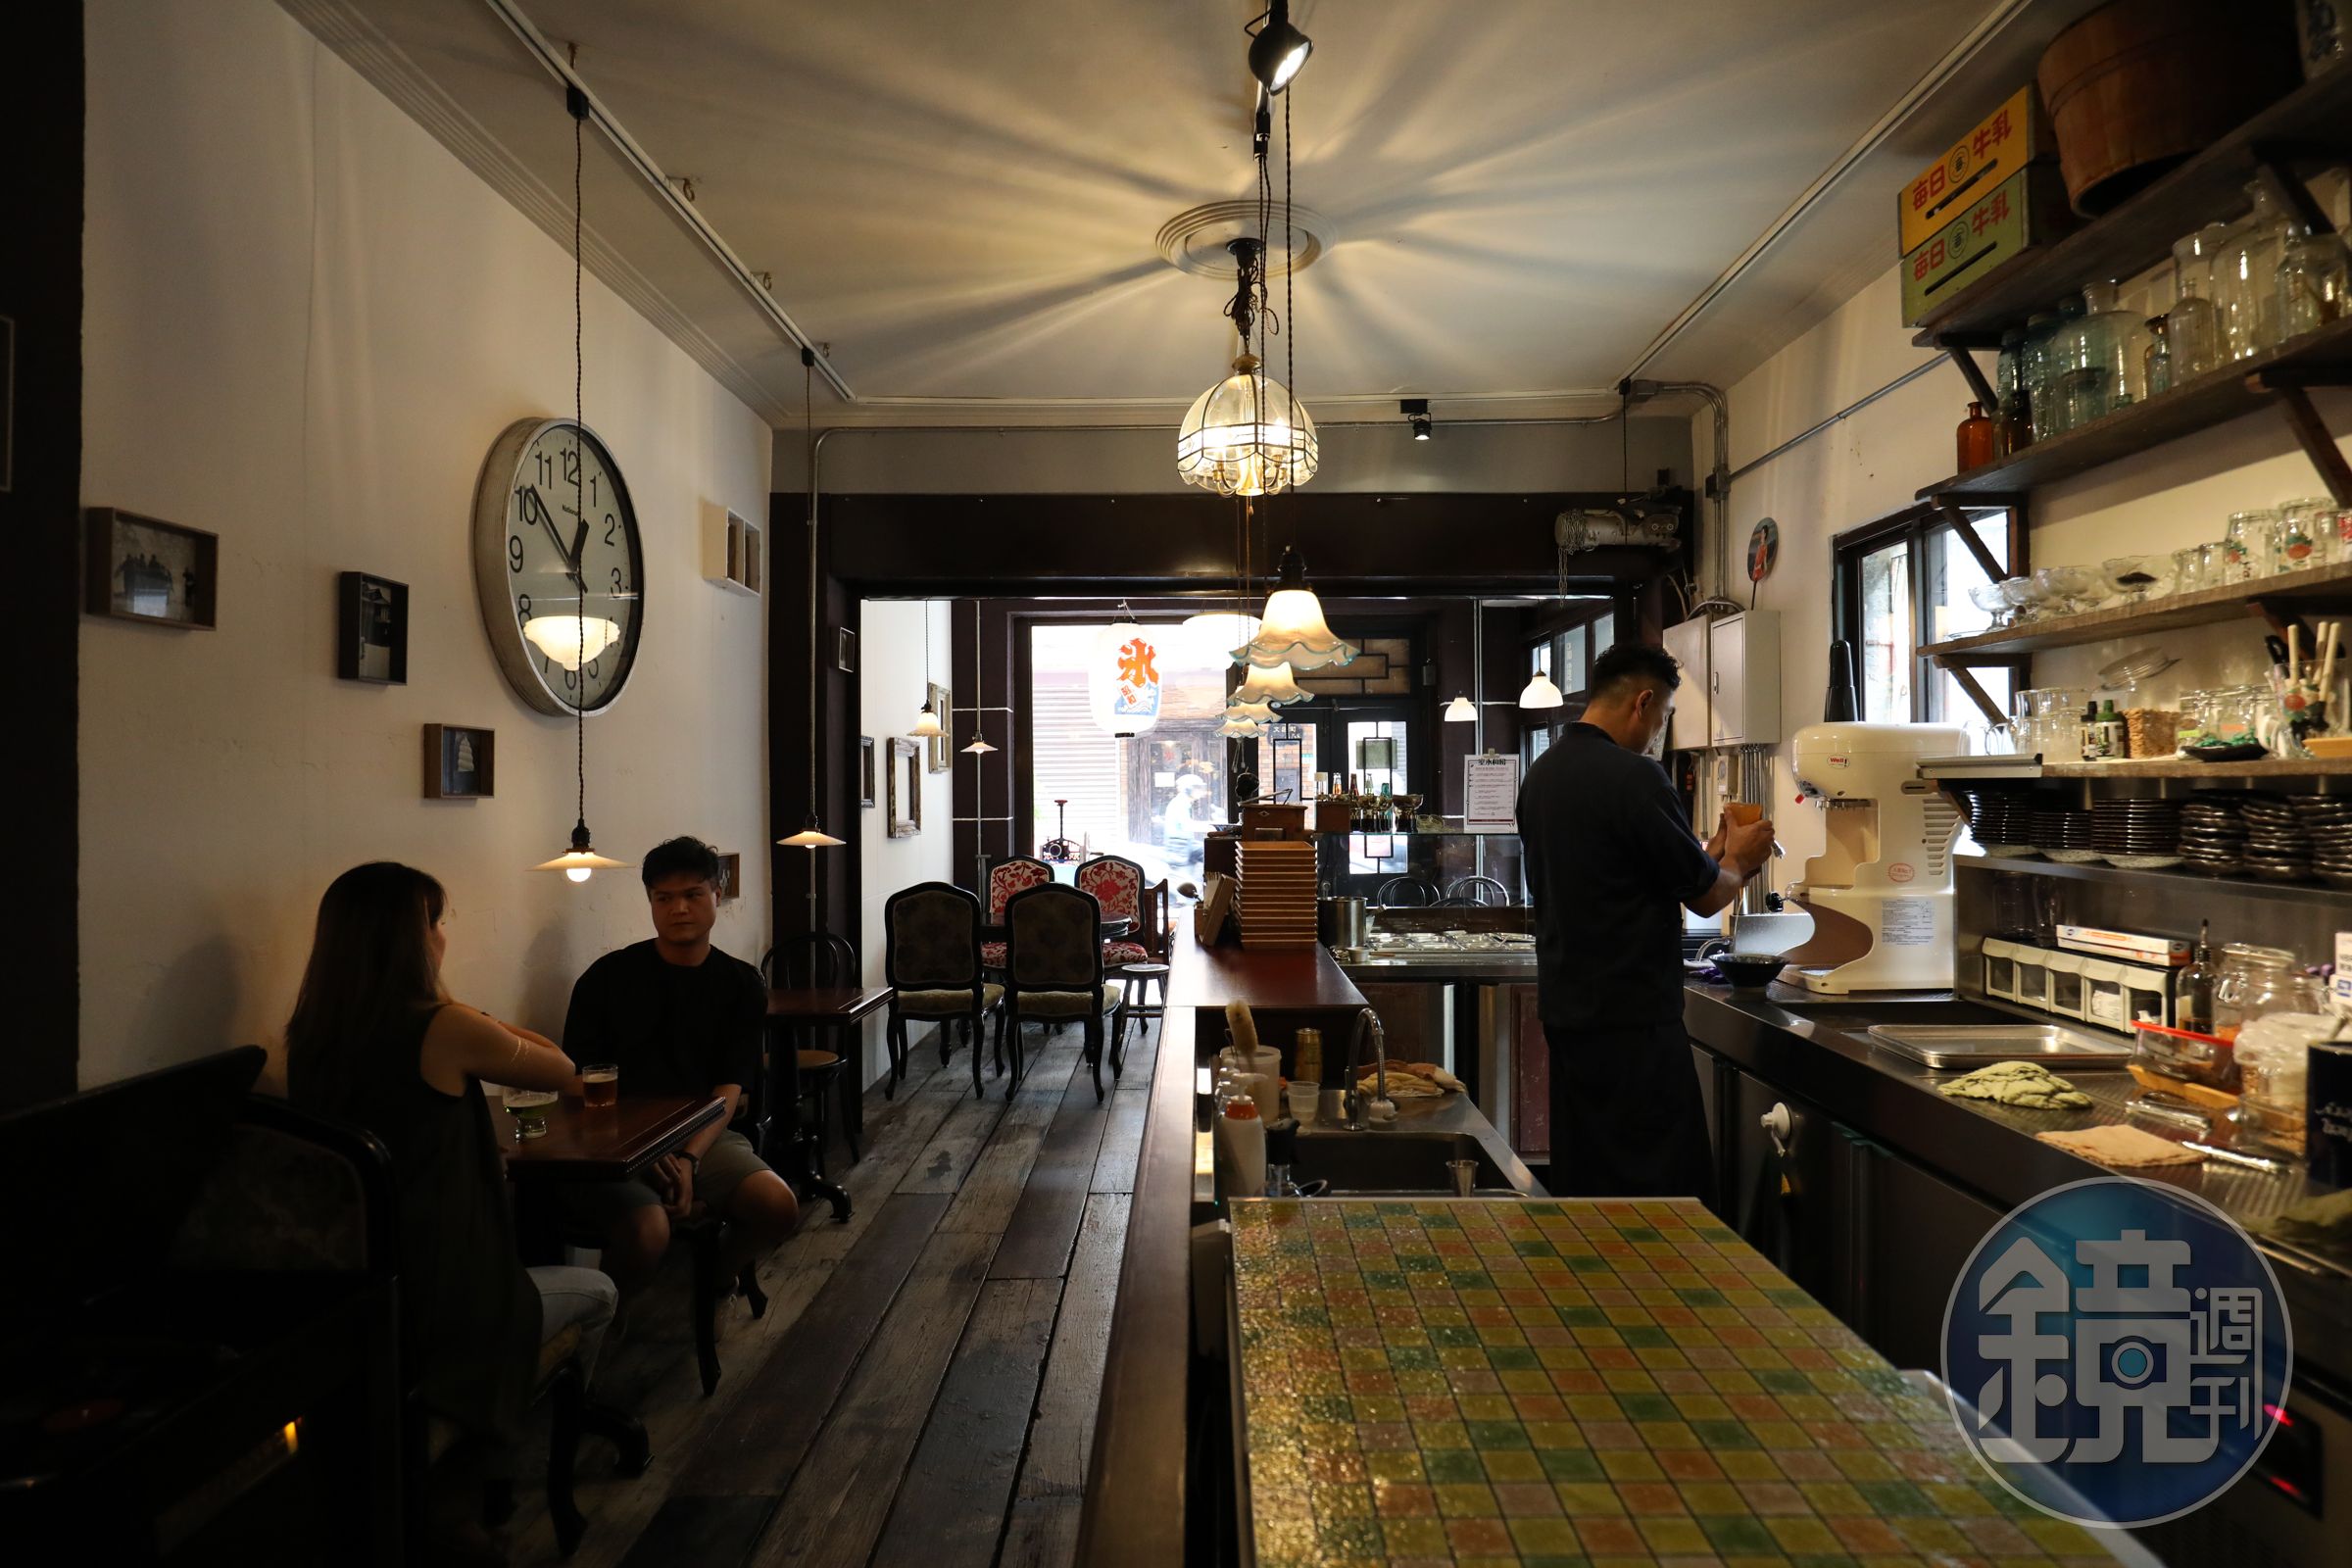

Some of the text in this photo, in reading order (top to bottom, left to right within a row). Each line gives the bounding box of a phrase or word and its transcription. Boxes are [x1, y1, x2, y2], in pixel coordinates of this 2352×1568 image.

[535, 450, 553, 490] 11
[560, 447, 580, 487] 12
[514, 485, 538, 526] 10
[589, 474, 598, 509] 1
[604, 513, 615, 547] 2
[509, 534, 524, 574] 9
[610, 566, 622, 599] 3
[517, 594, 533, 629] 8
